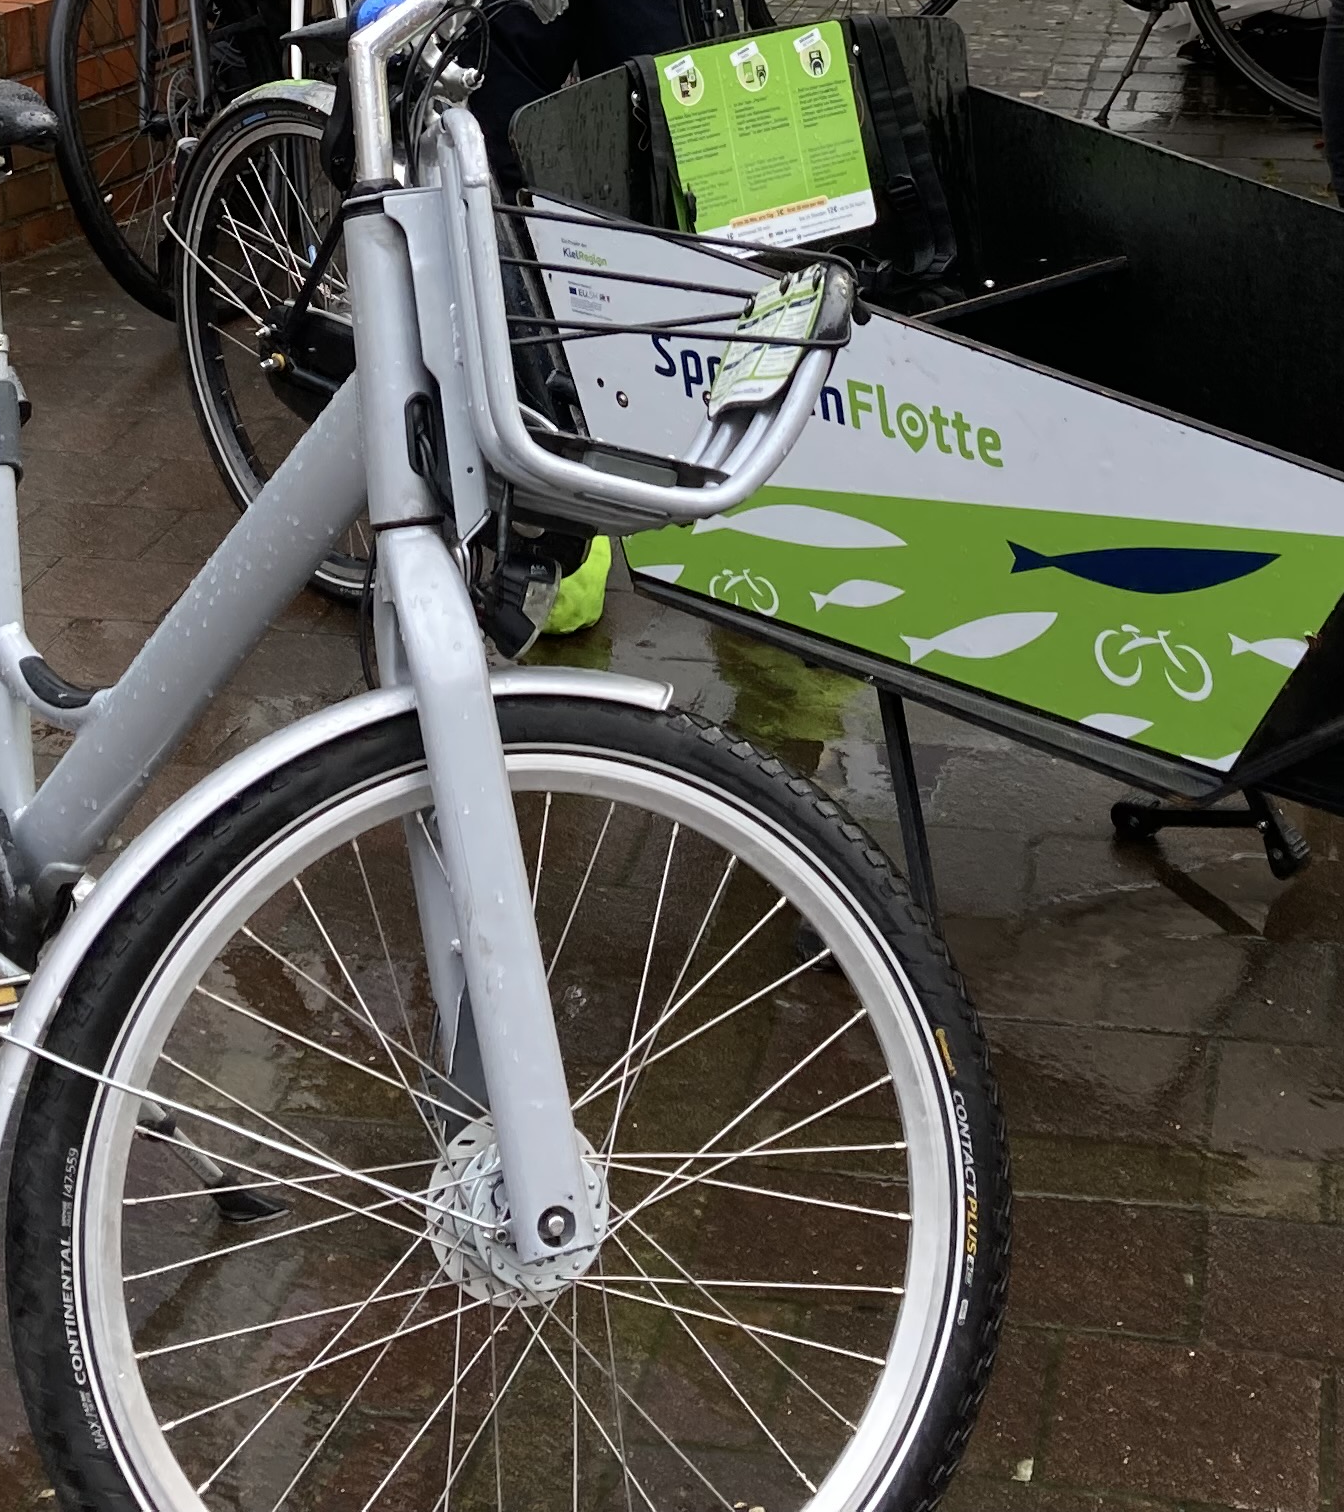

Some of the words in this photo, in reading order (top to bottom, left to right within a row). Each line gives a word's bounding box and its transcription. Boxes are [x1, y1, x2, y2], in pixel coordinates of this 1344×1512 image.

[563, 247, 608, 267] KielRegion
[953, 1090, 978, 1196] CONTACT
[966, 1195, 978, 1256] PLUS
[60, 1235, 87, 1386] CONTINENTAL
